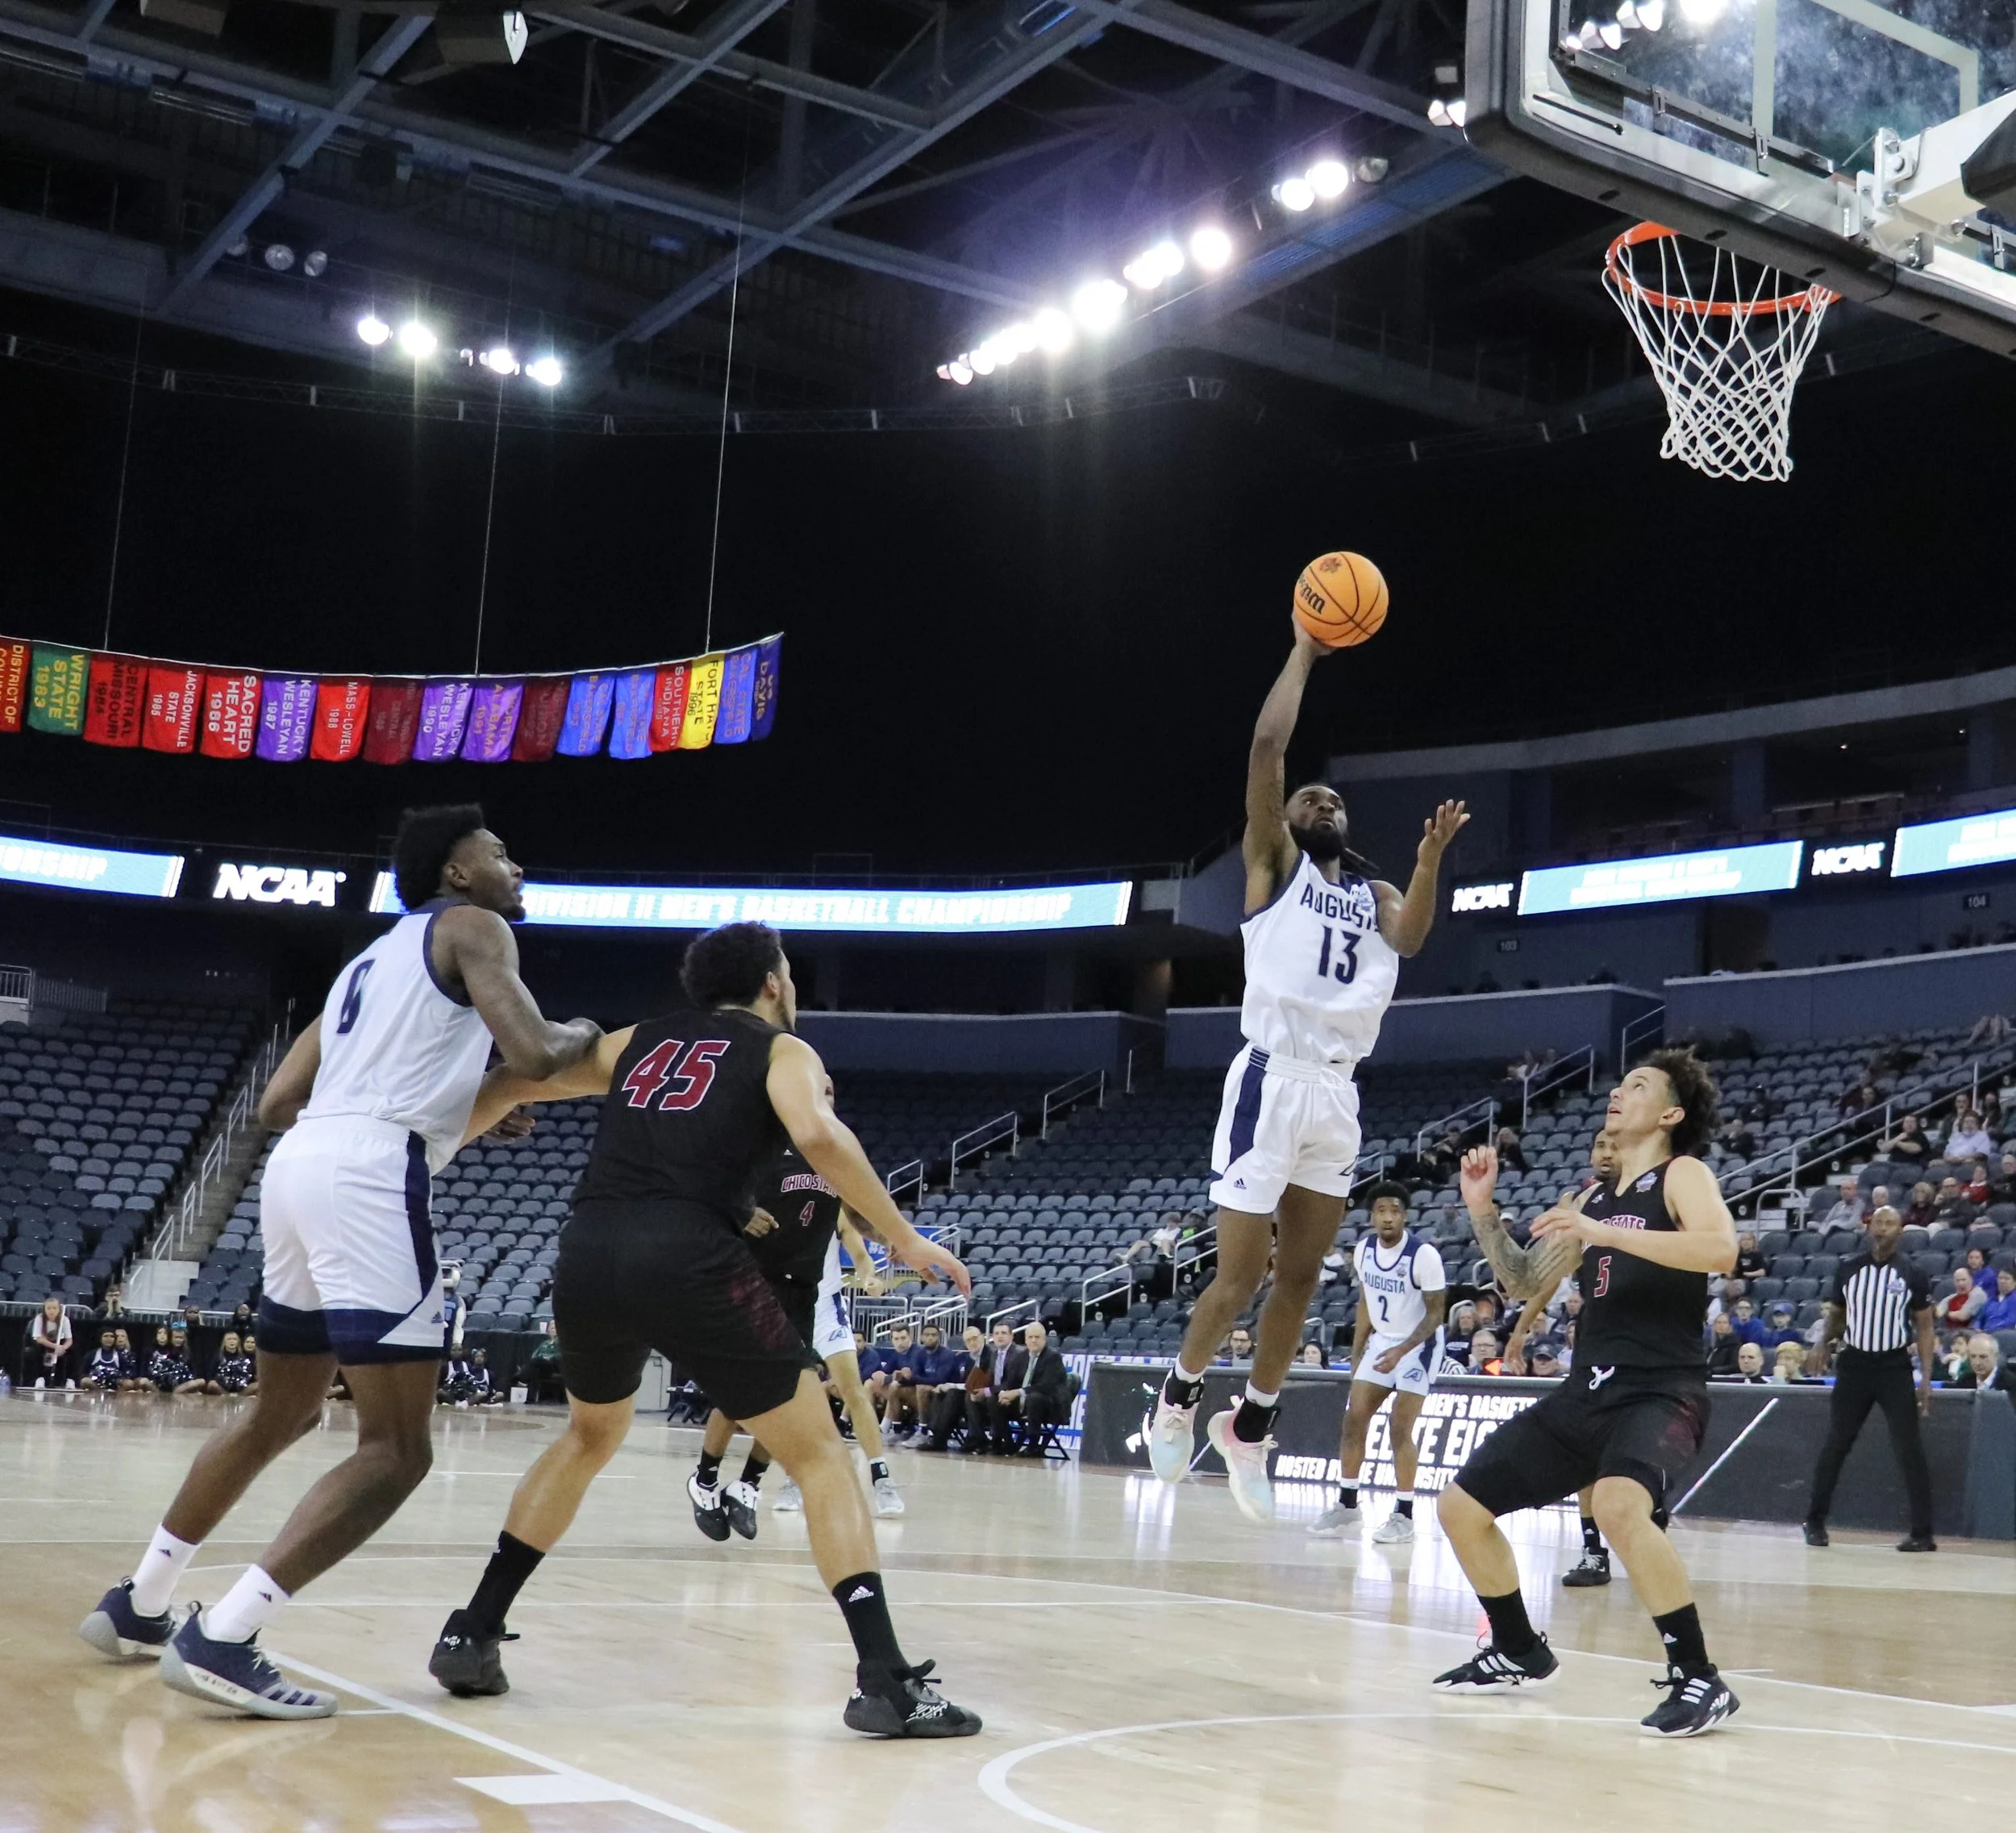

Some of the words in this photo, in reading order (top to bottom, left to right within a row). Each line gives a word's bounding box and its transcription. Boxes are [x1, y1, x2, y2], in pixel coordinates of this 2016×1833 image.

[7, 645, 24, 703] DISTRICT
[48, 660, 67, 719] STATE
[65, 654, 85, 730] WRIGHT
[108, 660, 124, 739] MISSOURI
[706, 660, 719, 698] FORT
[5, 706, 17, 724] OF
[165, 691, 179, 723] STATE
[177, 670, 197, 748] JACKSONVILLE
[208, 692, 223, 732] 1986
[223, 681, 240, 745] HEART
[238, 675, 256, 752] SACRED
[265, 701, 278, 730] 1987
[277, 680, 296, 755] WESLEYAN
[293, 680, 312, 754] KENTUCKY
[432, 684, 456, 756] WESLEYAN
[448, 683, 469, 755] KENTUCKY
[661, 677, 673, 737] INDIANA
[687, 692, 698, 716] 1996
[694, 681, 704, 725] STATE
[212, 863, 339, 907] NCAA
[522, 890, 631, 919] DIVISION
[635, 894, 656, 919] II
[658, 895, 737, 920] MEN'S
[741, 895, 890, 923] BASKETBALL
[897, 893, 1072, 924] CHAMPIONSHIP
[1318, 925, 1362, 984] 13
[621, 1039, 731, 1110] 45
[800, 1201, 815, 1227] 4
[1593, 1256, 1613, 1298] 5
[1377, 1295, 1389, 1323] 2
[1364, 1414, 1443, 1464] ELTE
[1274, 1454, 1327, 1481] HOSTED
